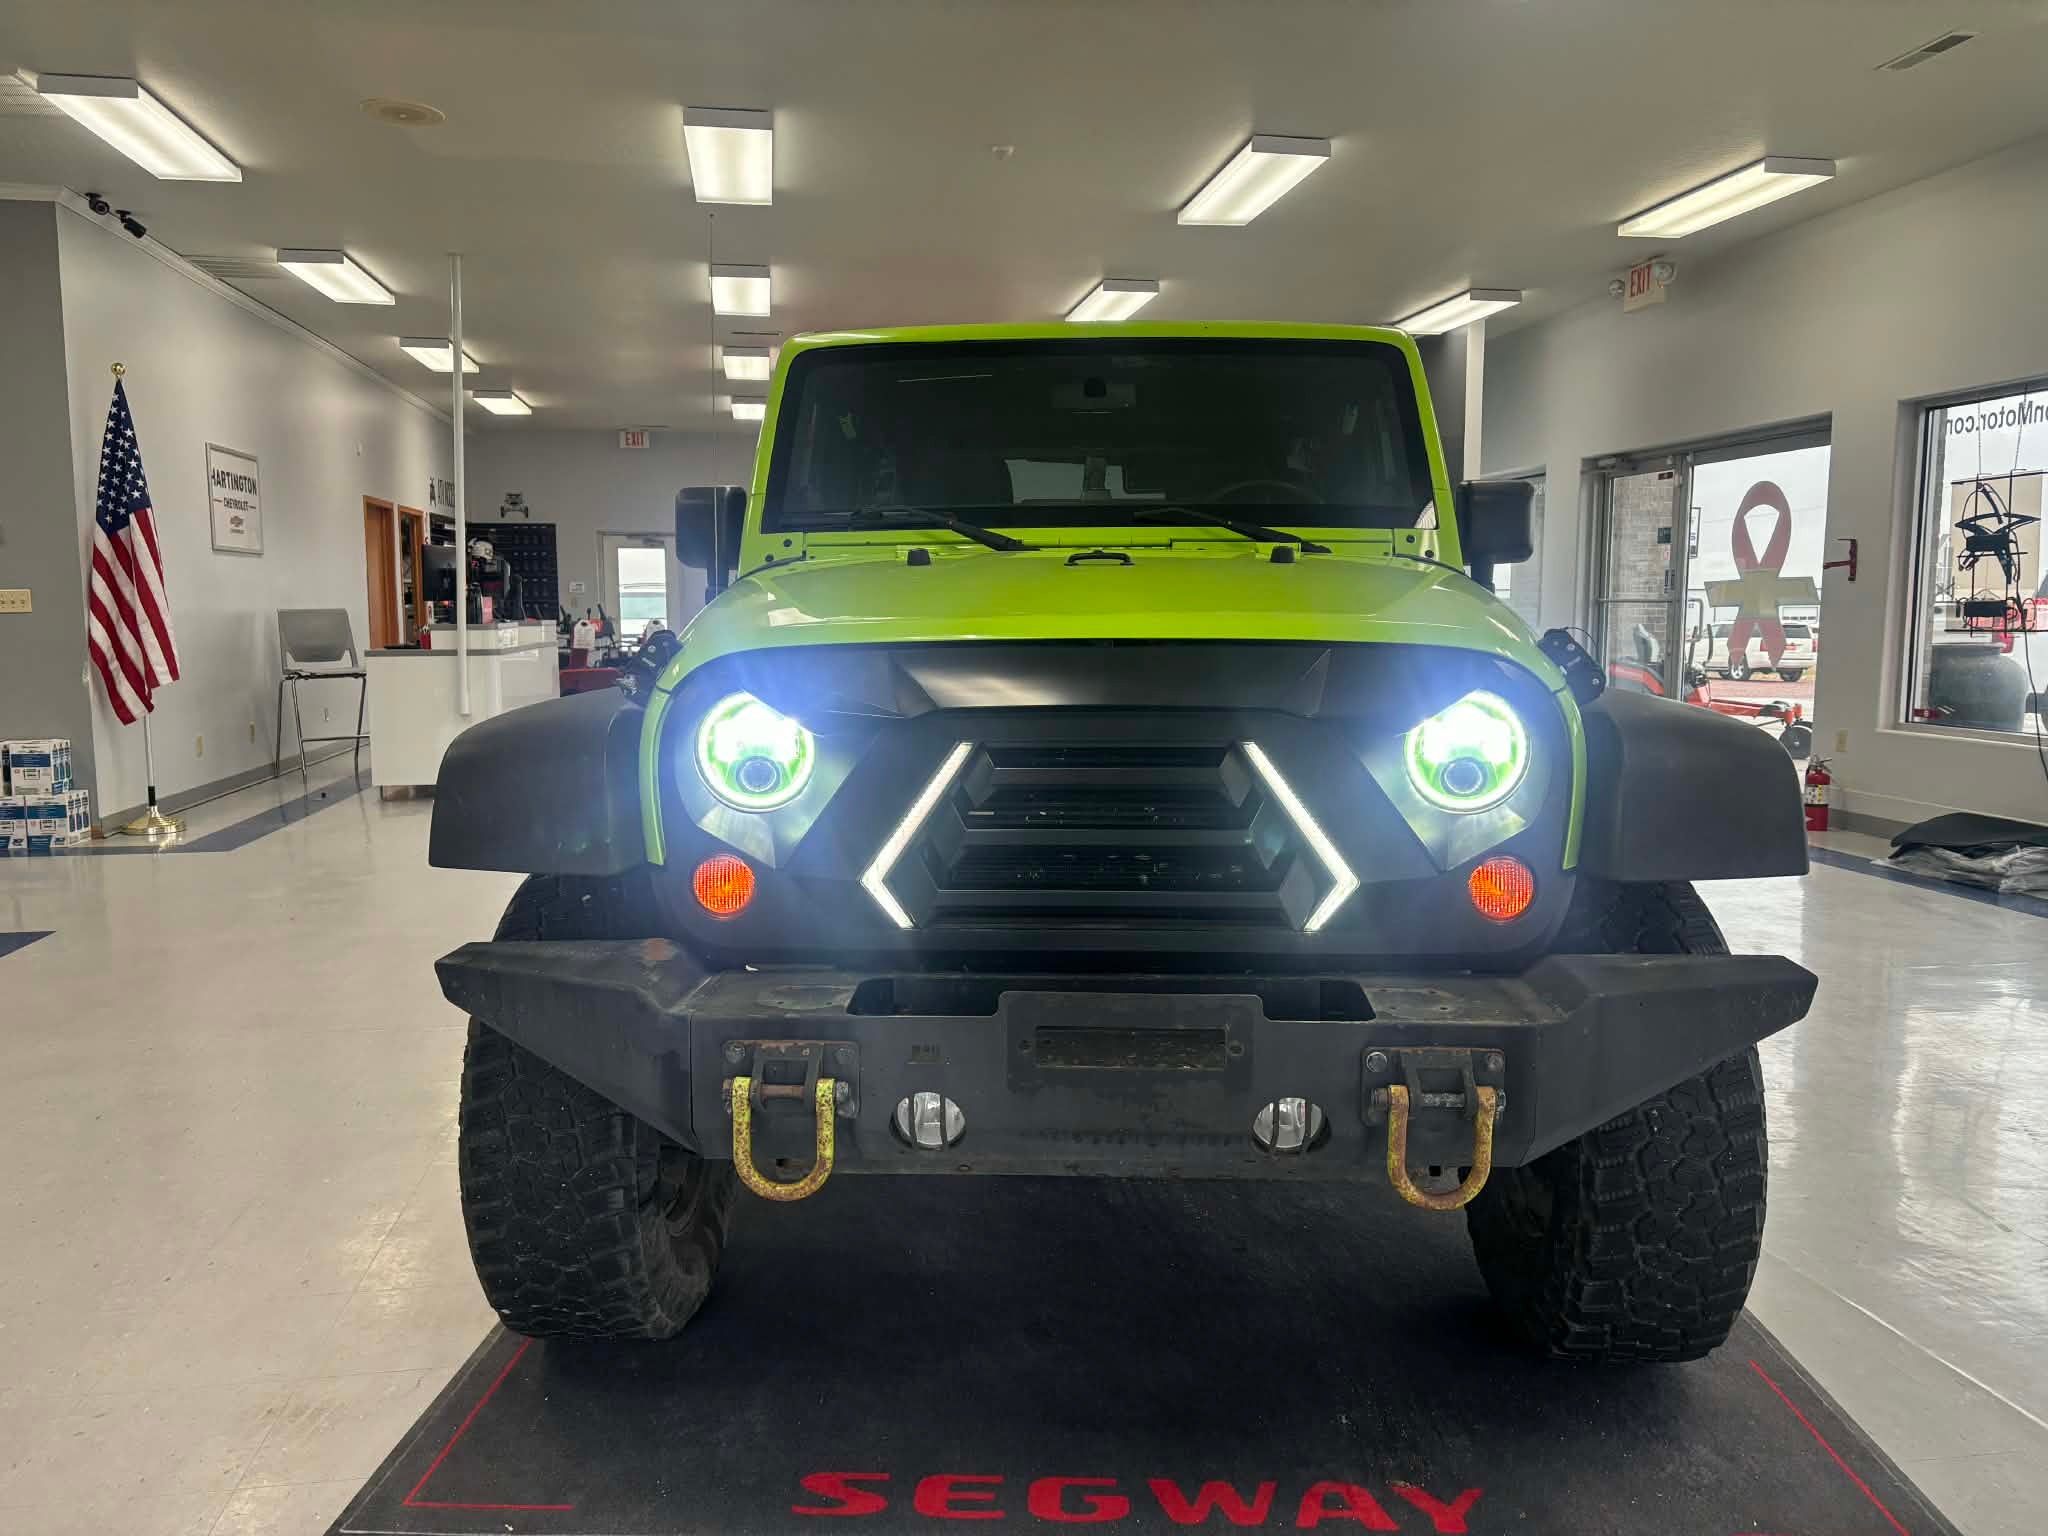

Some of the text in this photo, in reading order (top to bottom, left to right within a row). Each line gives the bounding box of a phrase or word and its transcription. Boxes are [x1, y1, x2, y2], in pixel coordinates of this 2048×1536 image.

[1631, 263, 1652, 297] EXIT
[625, 431, 645, 446] EXIT
[792, 1472, 1483, 1534] SEGWAY
